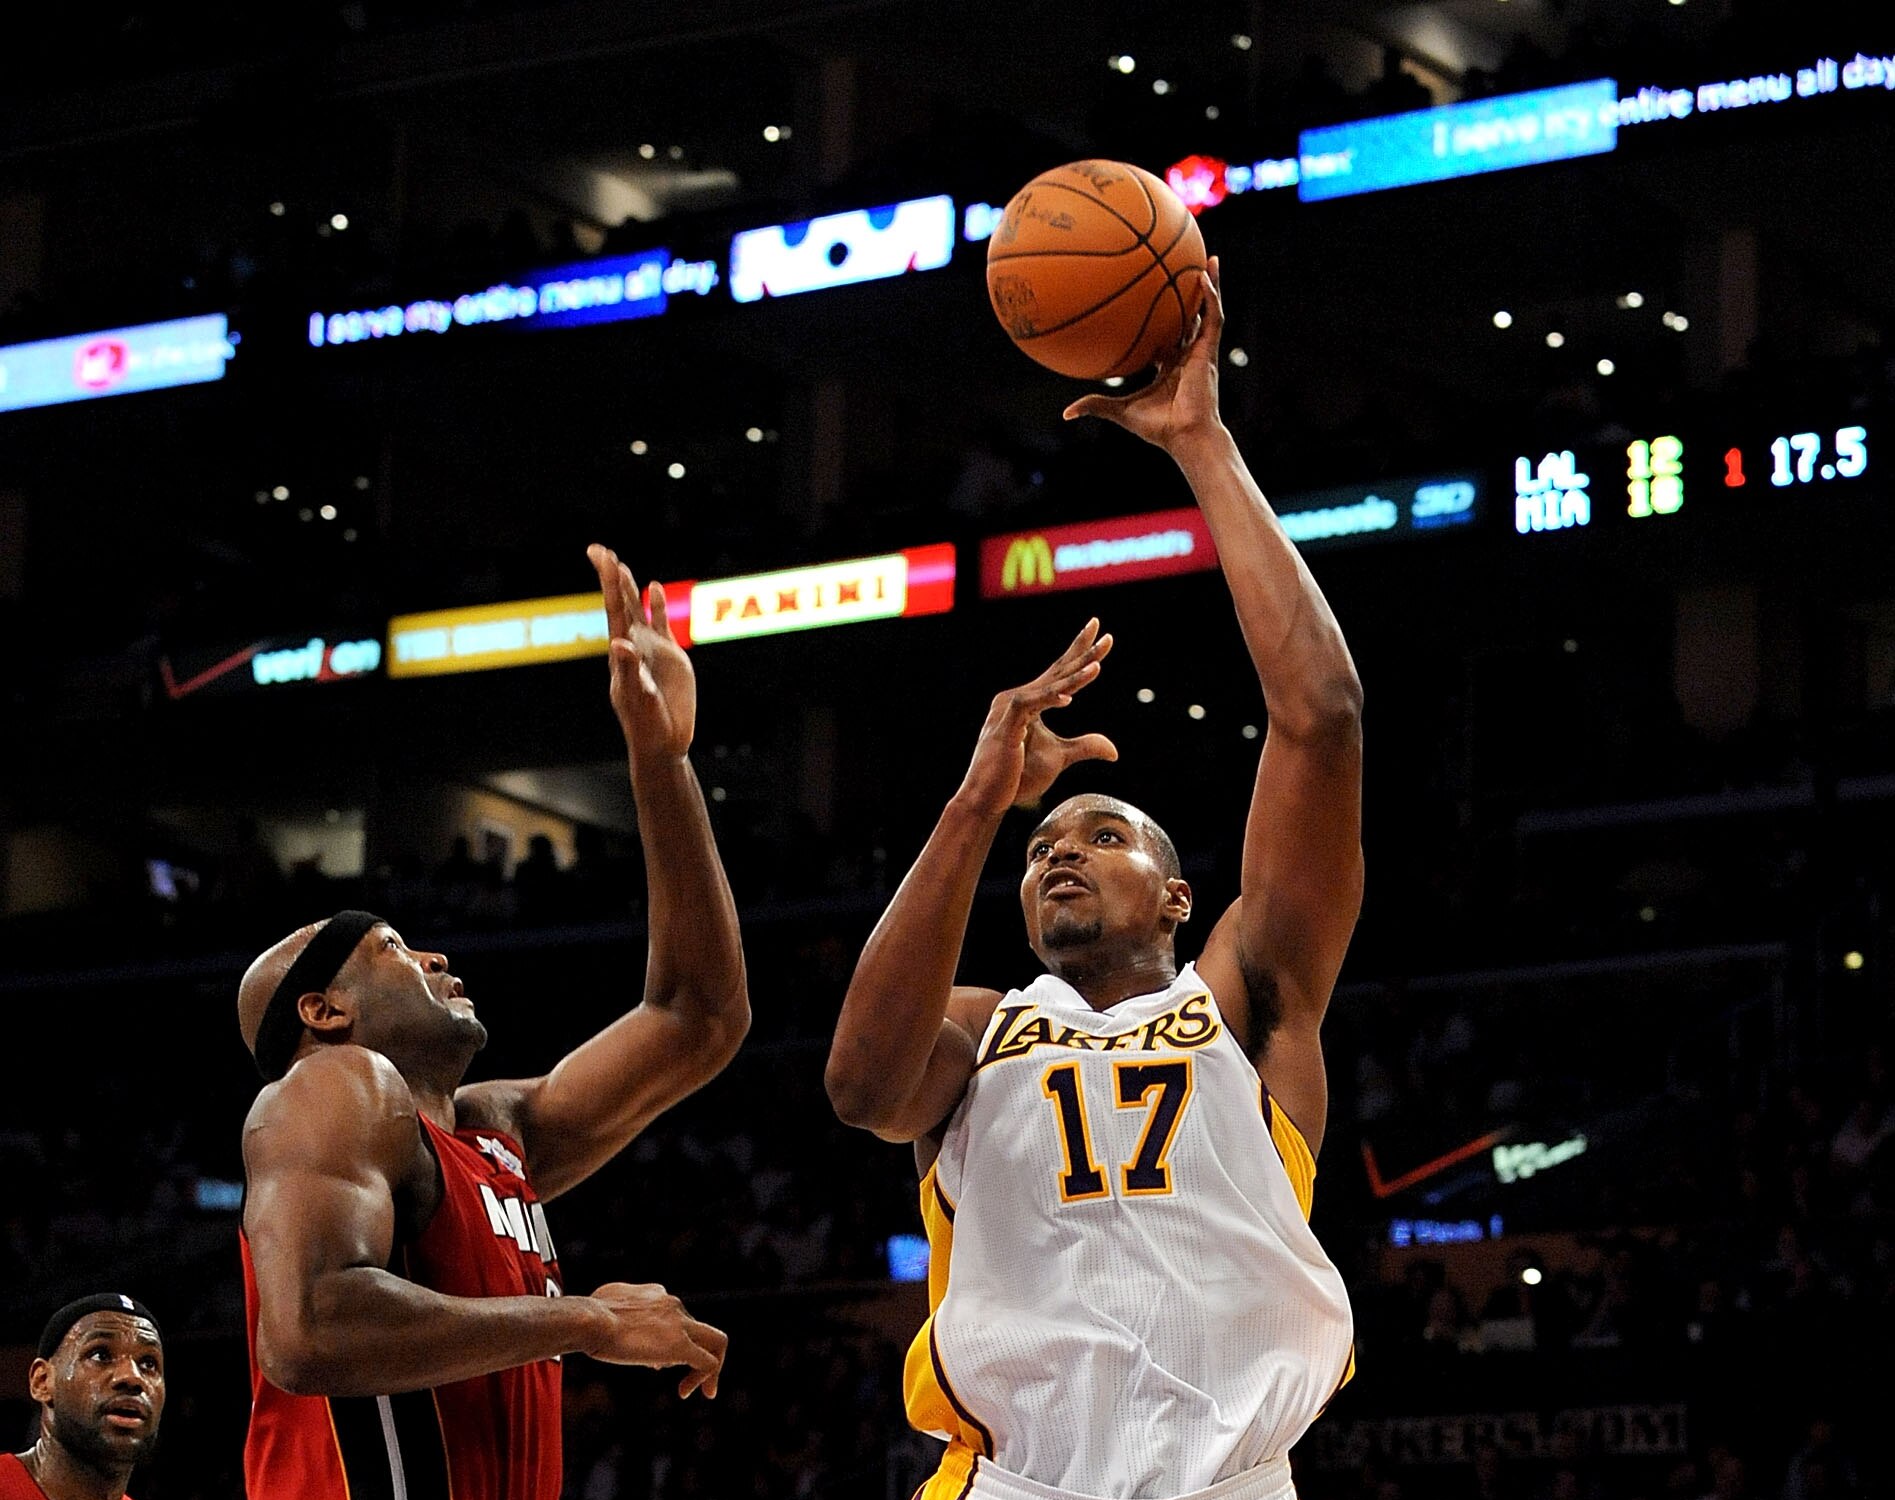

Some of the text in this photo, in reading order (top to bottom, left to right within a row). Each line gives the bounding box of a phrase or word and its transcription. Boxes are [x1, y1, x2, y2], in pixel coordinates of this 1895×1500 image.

[1697, 72, 1792, 113] menu
[1796, 56, 1838, 98] all
[1514, 425, 1867, 495] LAL 12 1 17.5
[1514, 487, 1591, 535] MIA
[714, 574, 888, 623] PANINI
[1039, 1055, 1195, 1205] 17
